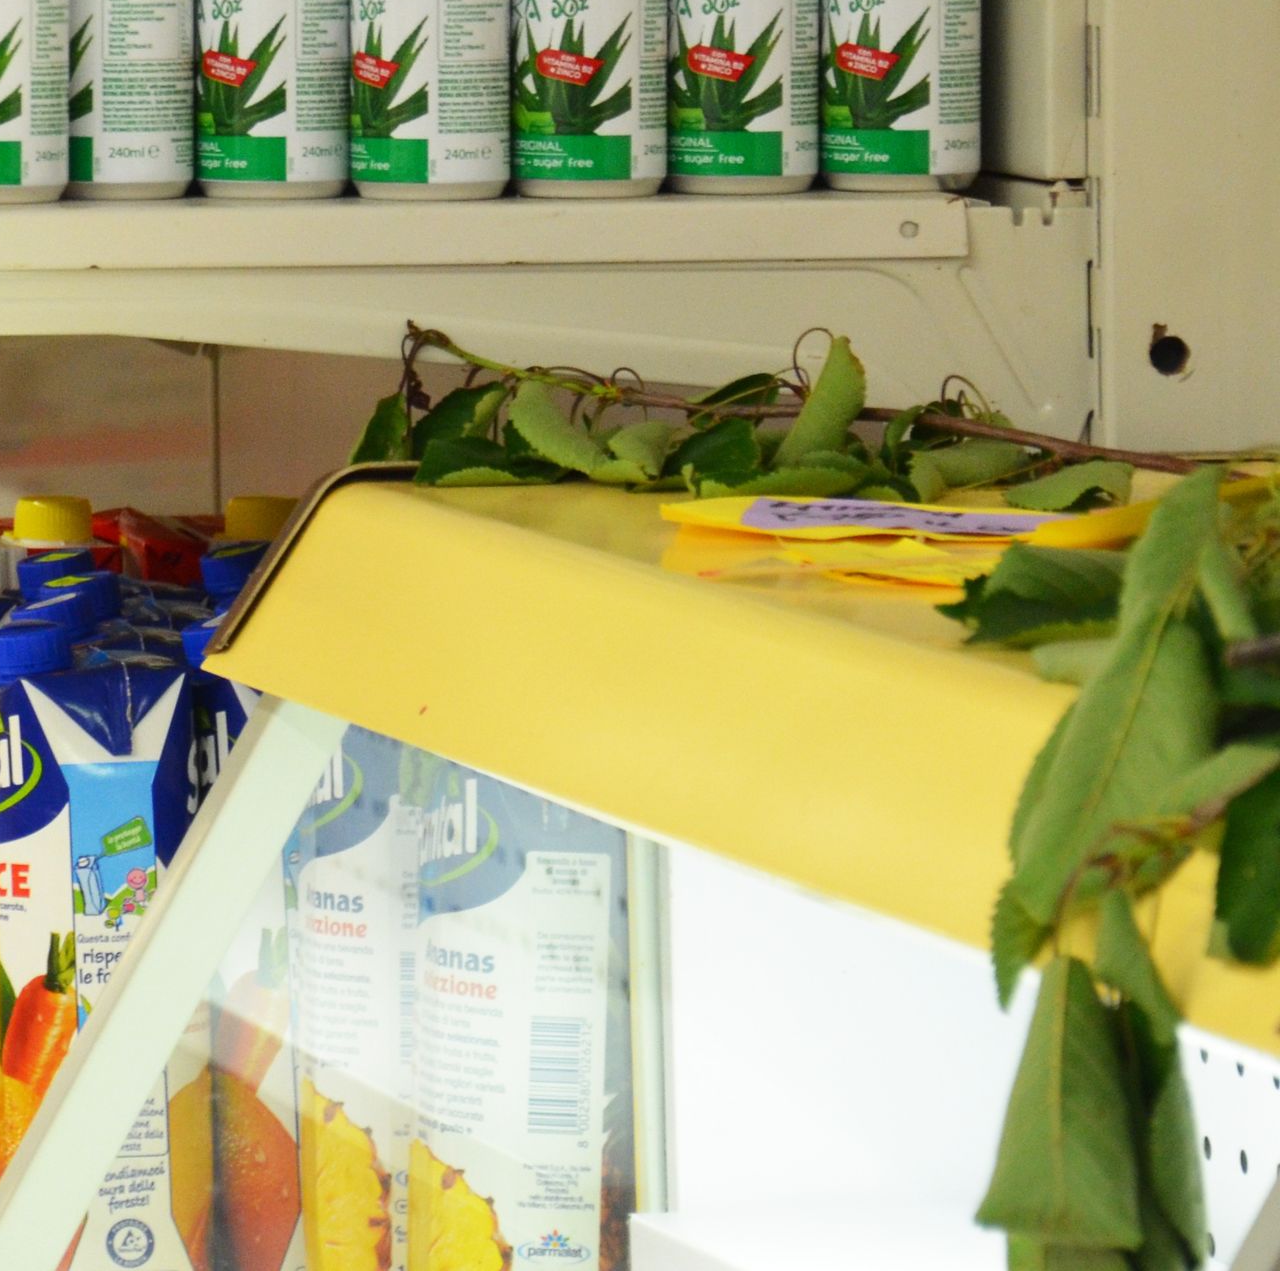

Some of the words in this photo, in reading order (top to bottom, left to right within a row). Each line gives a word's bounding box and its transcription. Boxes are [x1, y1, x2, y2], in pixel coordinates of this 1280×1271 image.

[108, 146, 145, 159] 240ml
[443, 148, 480, 161] 240ml
[718, 152, 745, 164] free
[864, 151, 890, 163] free
[567, 156, 594, 169] free
[77, 932, 109, 945] Questa
[79, 967, 94, 985] le
[98, 1184, 125, 1197] cura
[128, 1179, 156, 1193] delle
[108, 1194, 151, 1214] foreste!
[527, 1244, 583, 1260] parmalat
